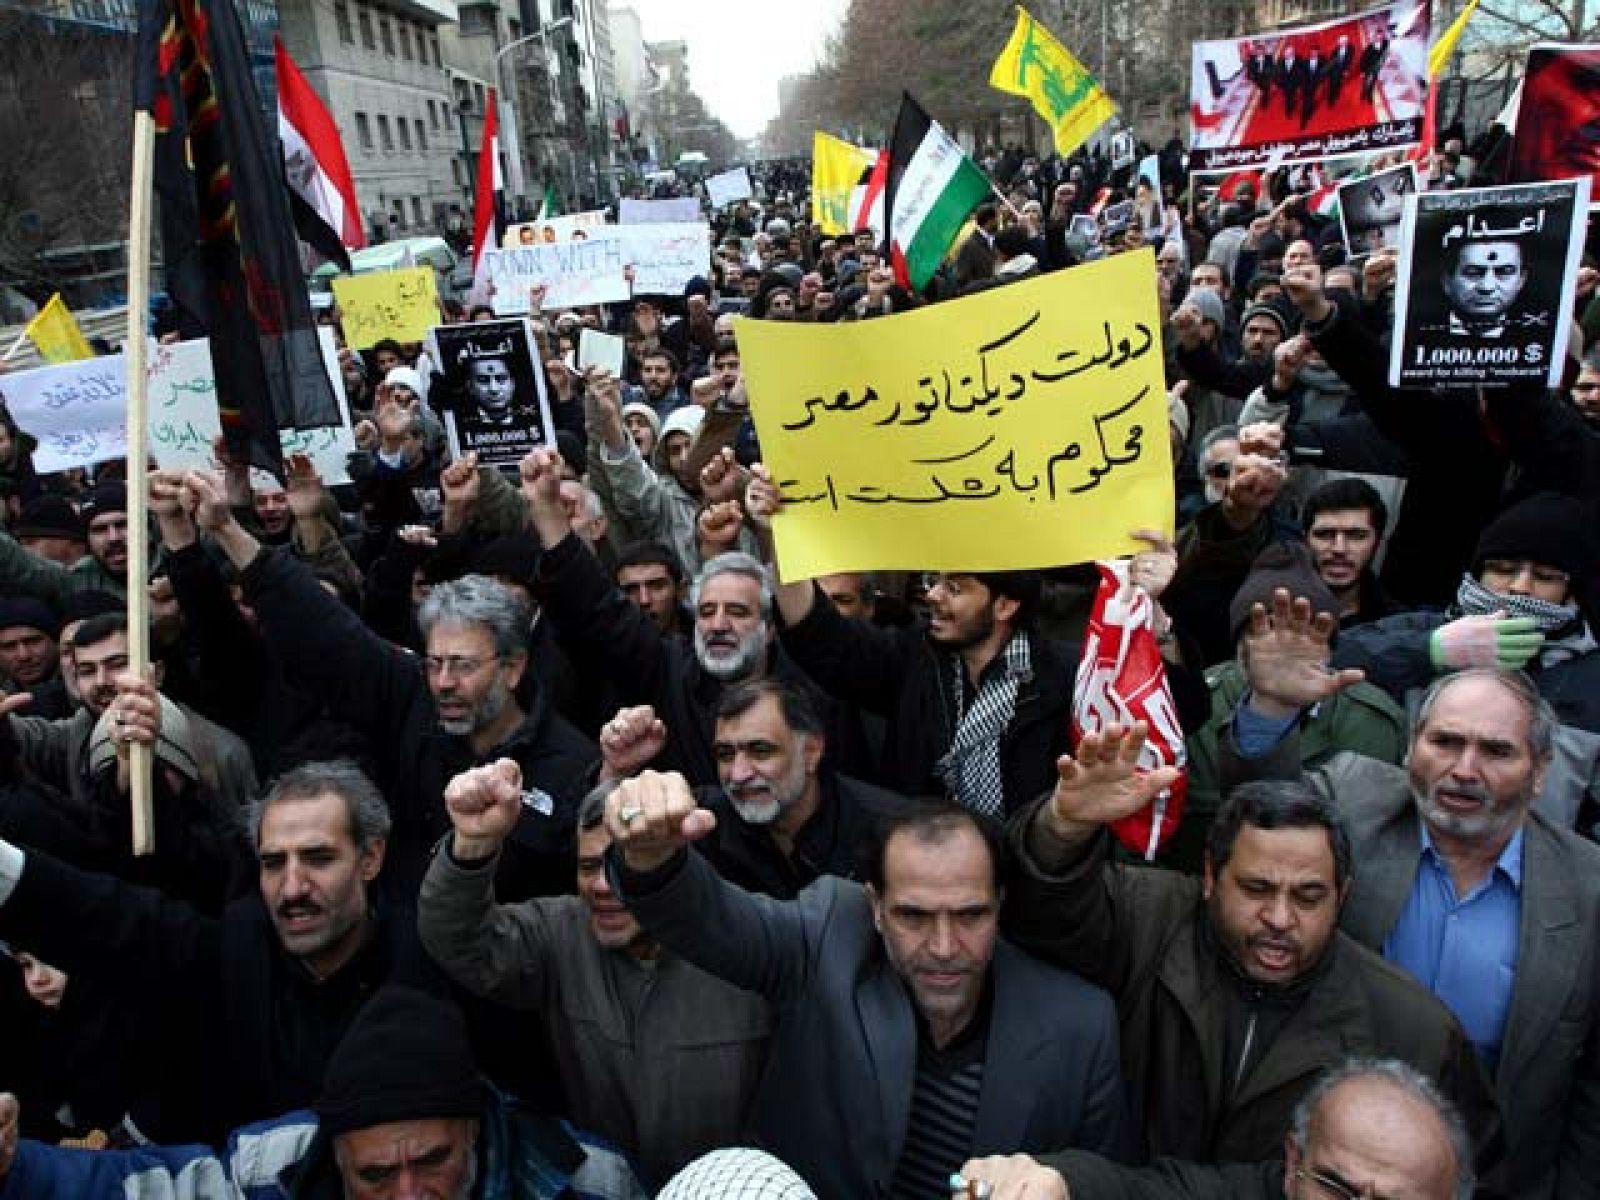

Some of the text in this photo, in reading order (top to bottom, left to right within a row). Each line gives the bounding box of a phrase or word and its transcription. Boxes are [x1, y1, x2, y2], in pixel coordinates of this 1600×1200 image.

[1031, 320, 1153, 382] دولت
[1524, 342, 1544, 363] $
[781, 386, 879, 431] مصر
[846, 434, 1001, 504] شکست
[1046, 384, 1151, 501] محکوم
[995, 448, 1039, 502] به
